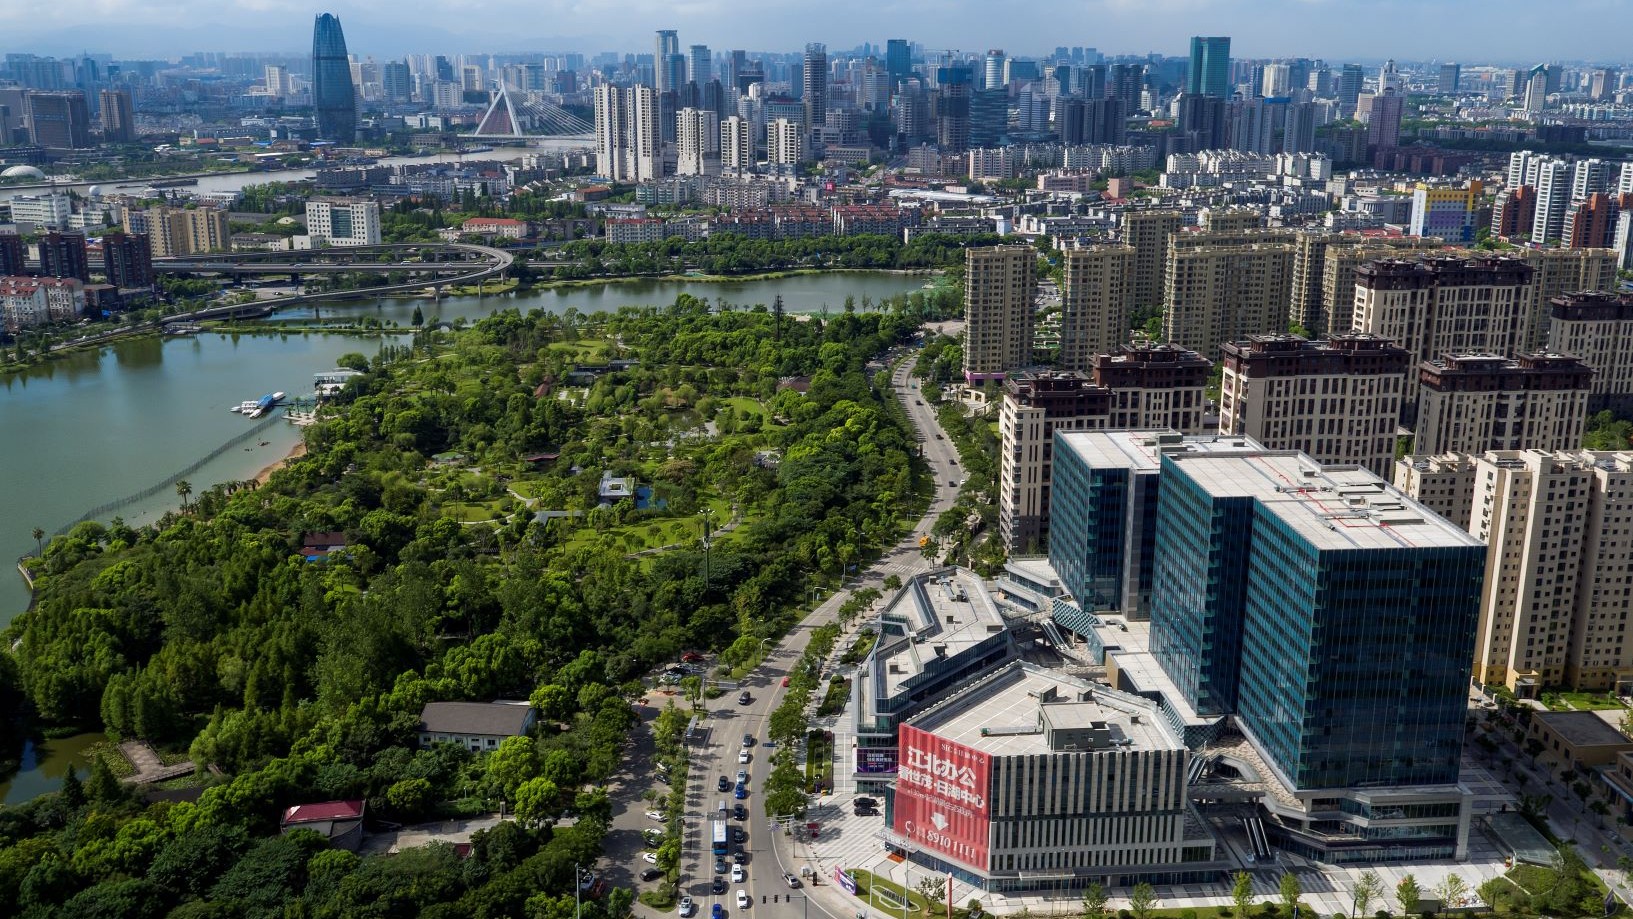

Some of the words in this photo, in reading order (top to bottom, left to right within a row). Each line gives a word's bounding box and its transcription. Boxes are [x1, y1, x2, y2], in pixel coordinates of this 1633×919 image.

[907, 745, 977, 789] 江北办公
[927, 830, 951, 848] 8910
